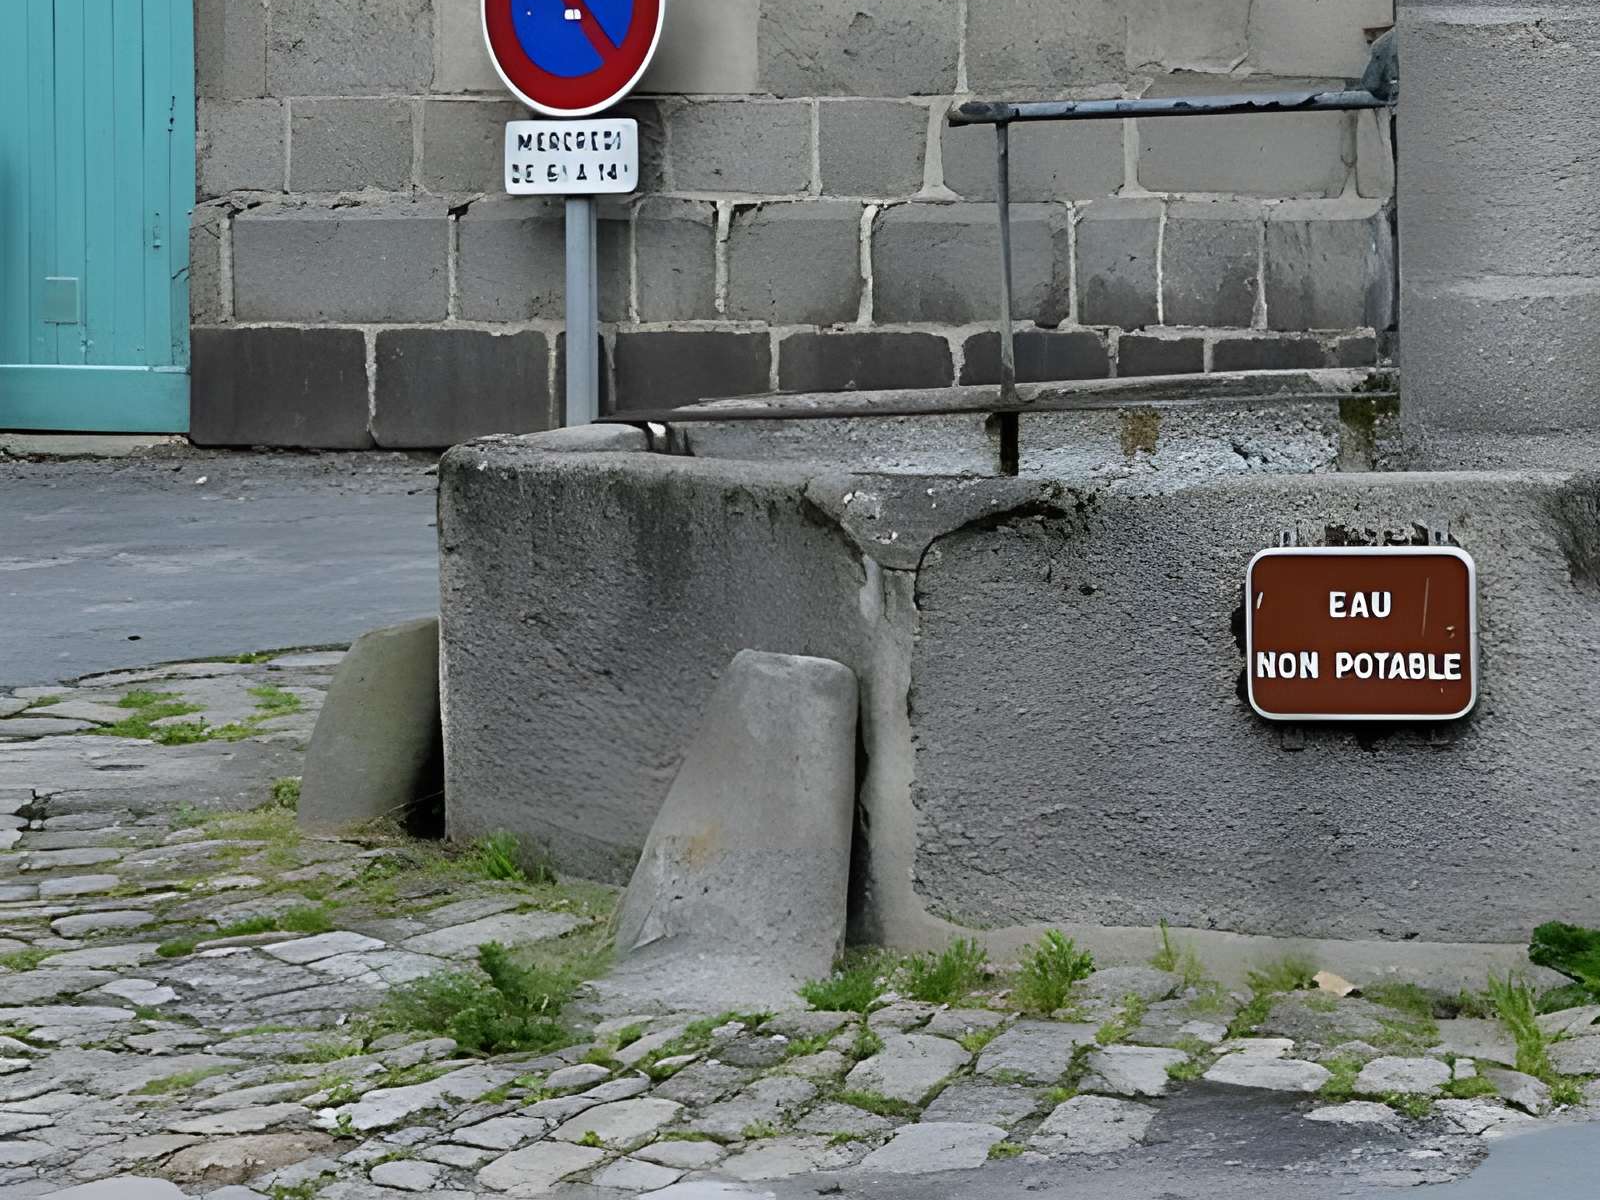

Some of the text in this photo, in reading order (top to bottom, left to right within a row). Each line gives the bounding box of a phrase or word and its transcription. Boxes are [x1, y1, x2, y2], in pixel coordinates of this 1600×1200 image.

[547, 164, 567, 182] 6
[598, 163, 629, 181] 14
[1329, 591, 1391, 618] EAU
[1256, 651, 1462, 680] NON POTABLE
